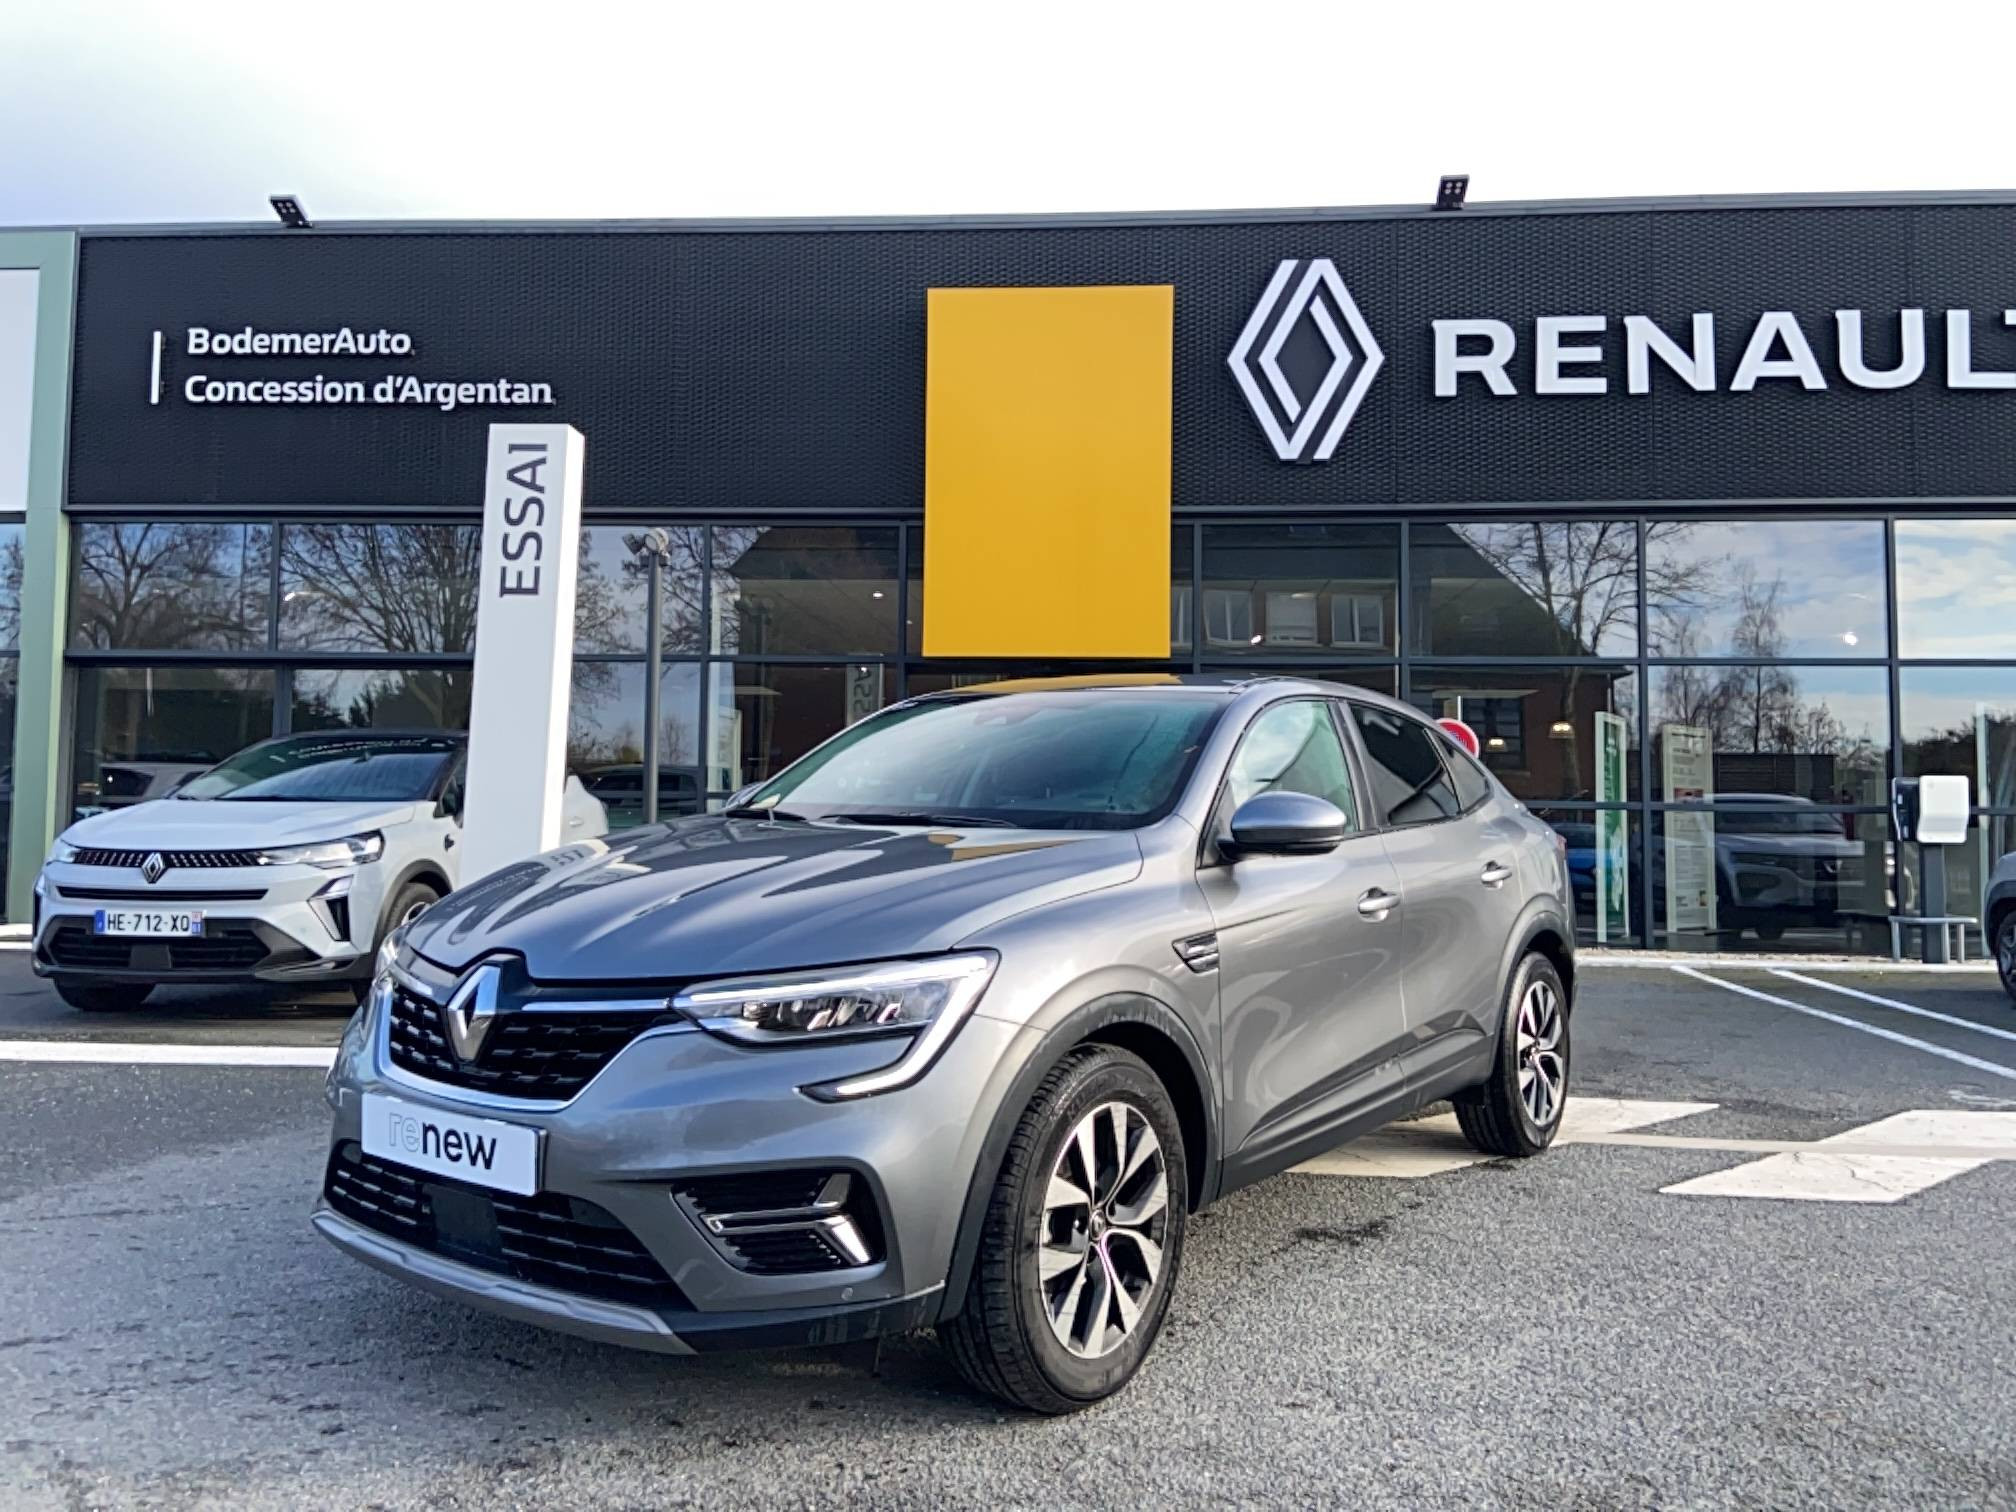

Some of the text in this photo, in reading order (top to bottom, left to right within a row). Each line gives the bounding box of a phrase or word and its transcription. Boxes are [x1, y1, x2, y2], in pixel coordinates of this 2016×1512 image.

[187, 327, 412, 354] BodemerAuto
[1432, 308, 2016, 396] RENAUL
[185, 374, 552, 410] Concession d'Argentan
[499, 443, 548, 598] ESSAI
[388, 1112, 498, 1170] renew
